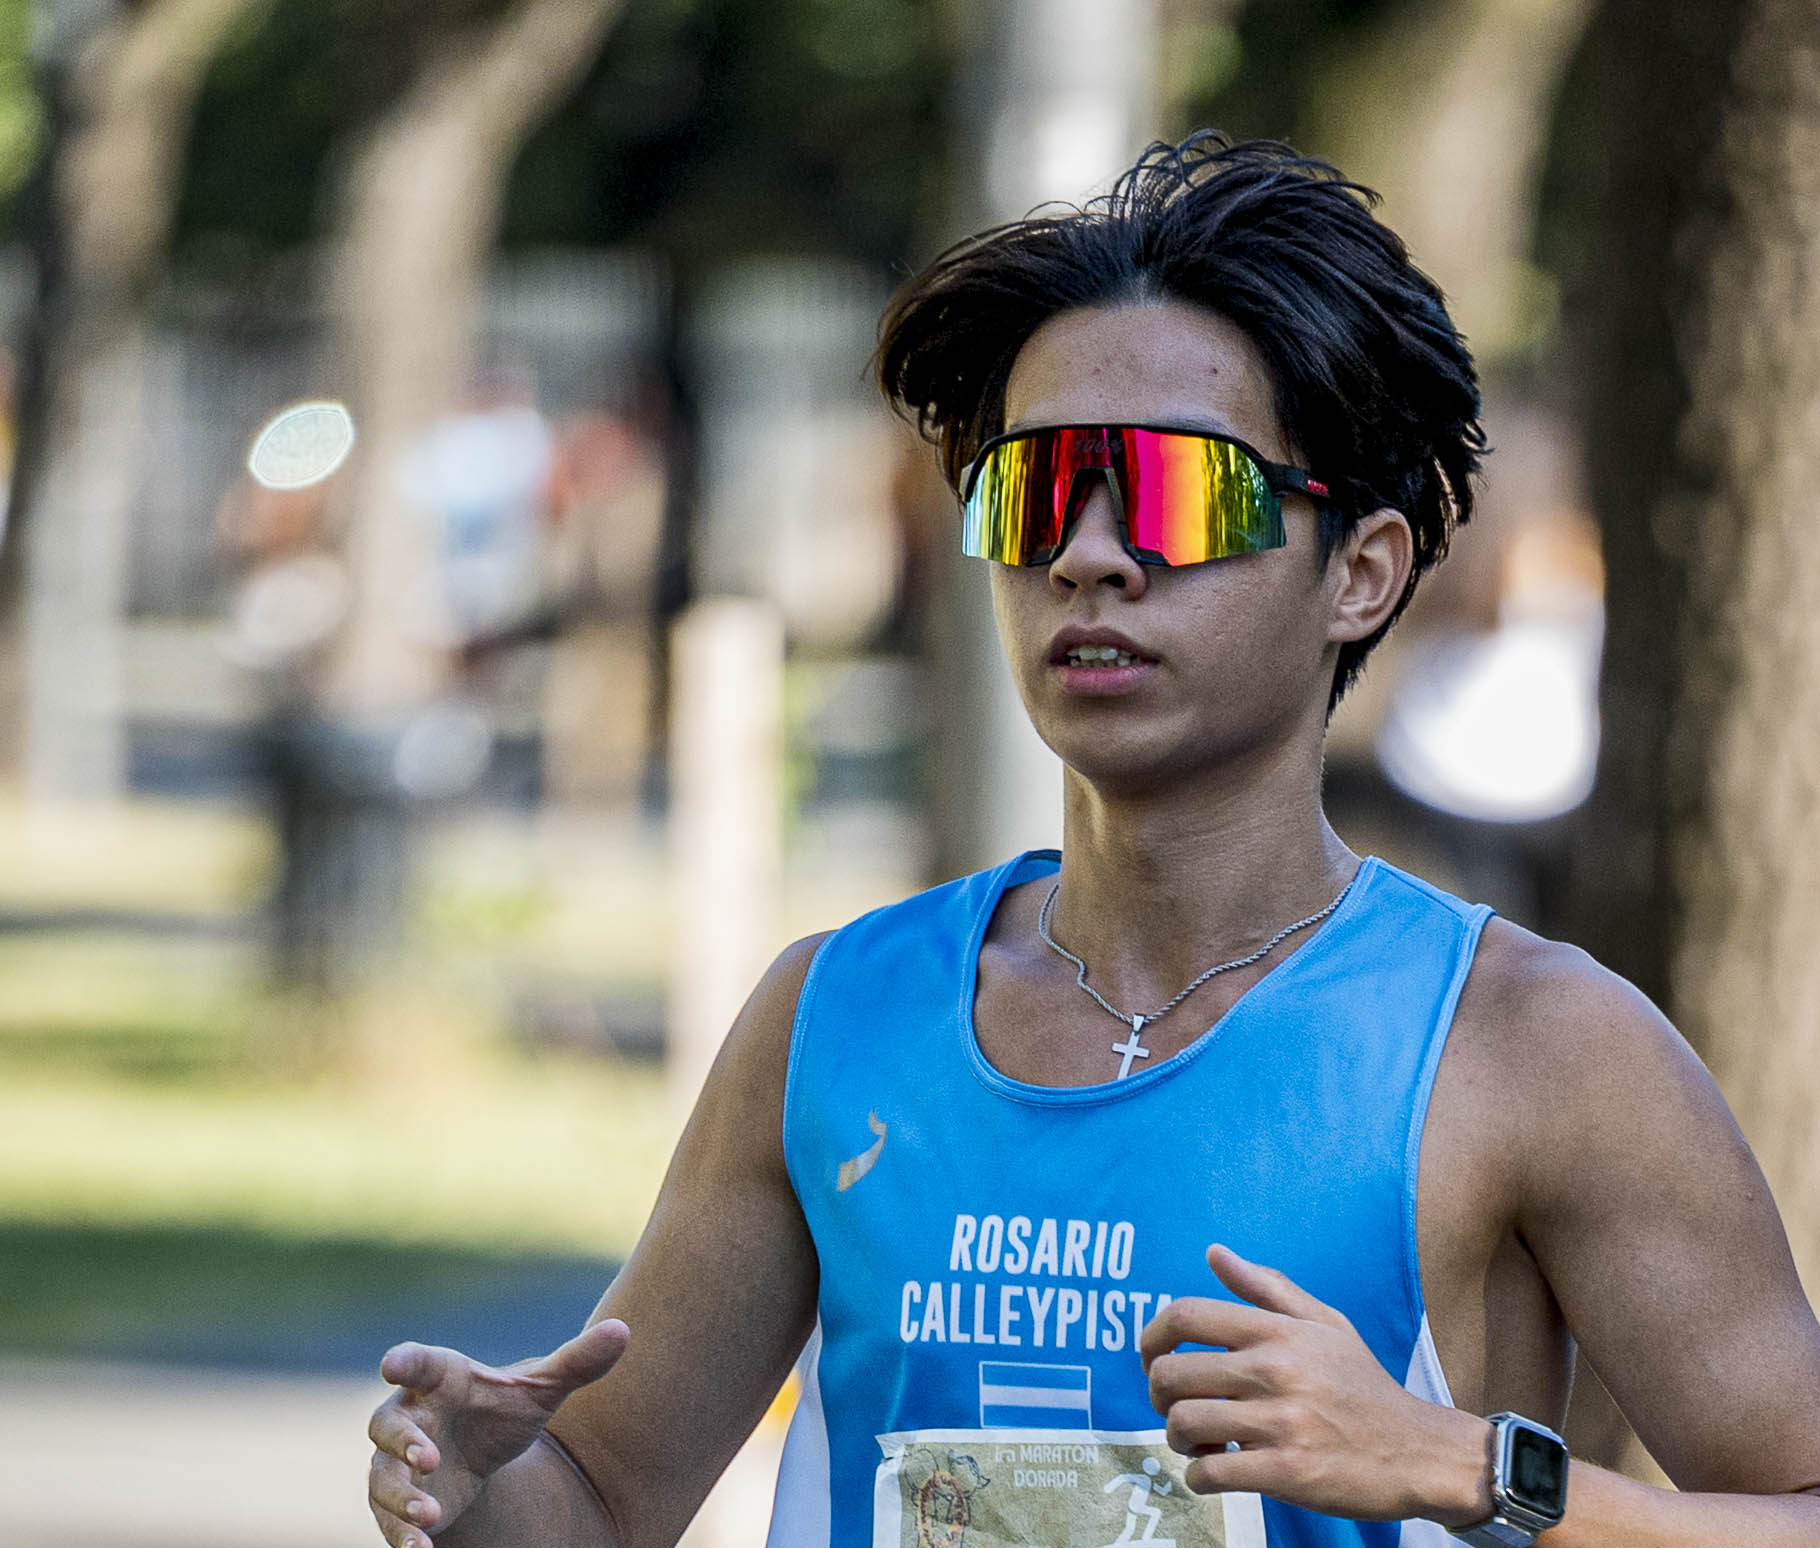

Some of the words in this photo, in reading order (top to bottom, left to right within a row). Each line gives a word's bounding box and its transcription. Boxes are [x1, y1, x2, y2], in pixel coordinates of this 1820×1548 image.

[949, 1213, 1136, 1281] ROSARIO
[1019, 1444, 1100, 1465] MARATON
[1012, 1469, 1079, 1490] DORADA
